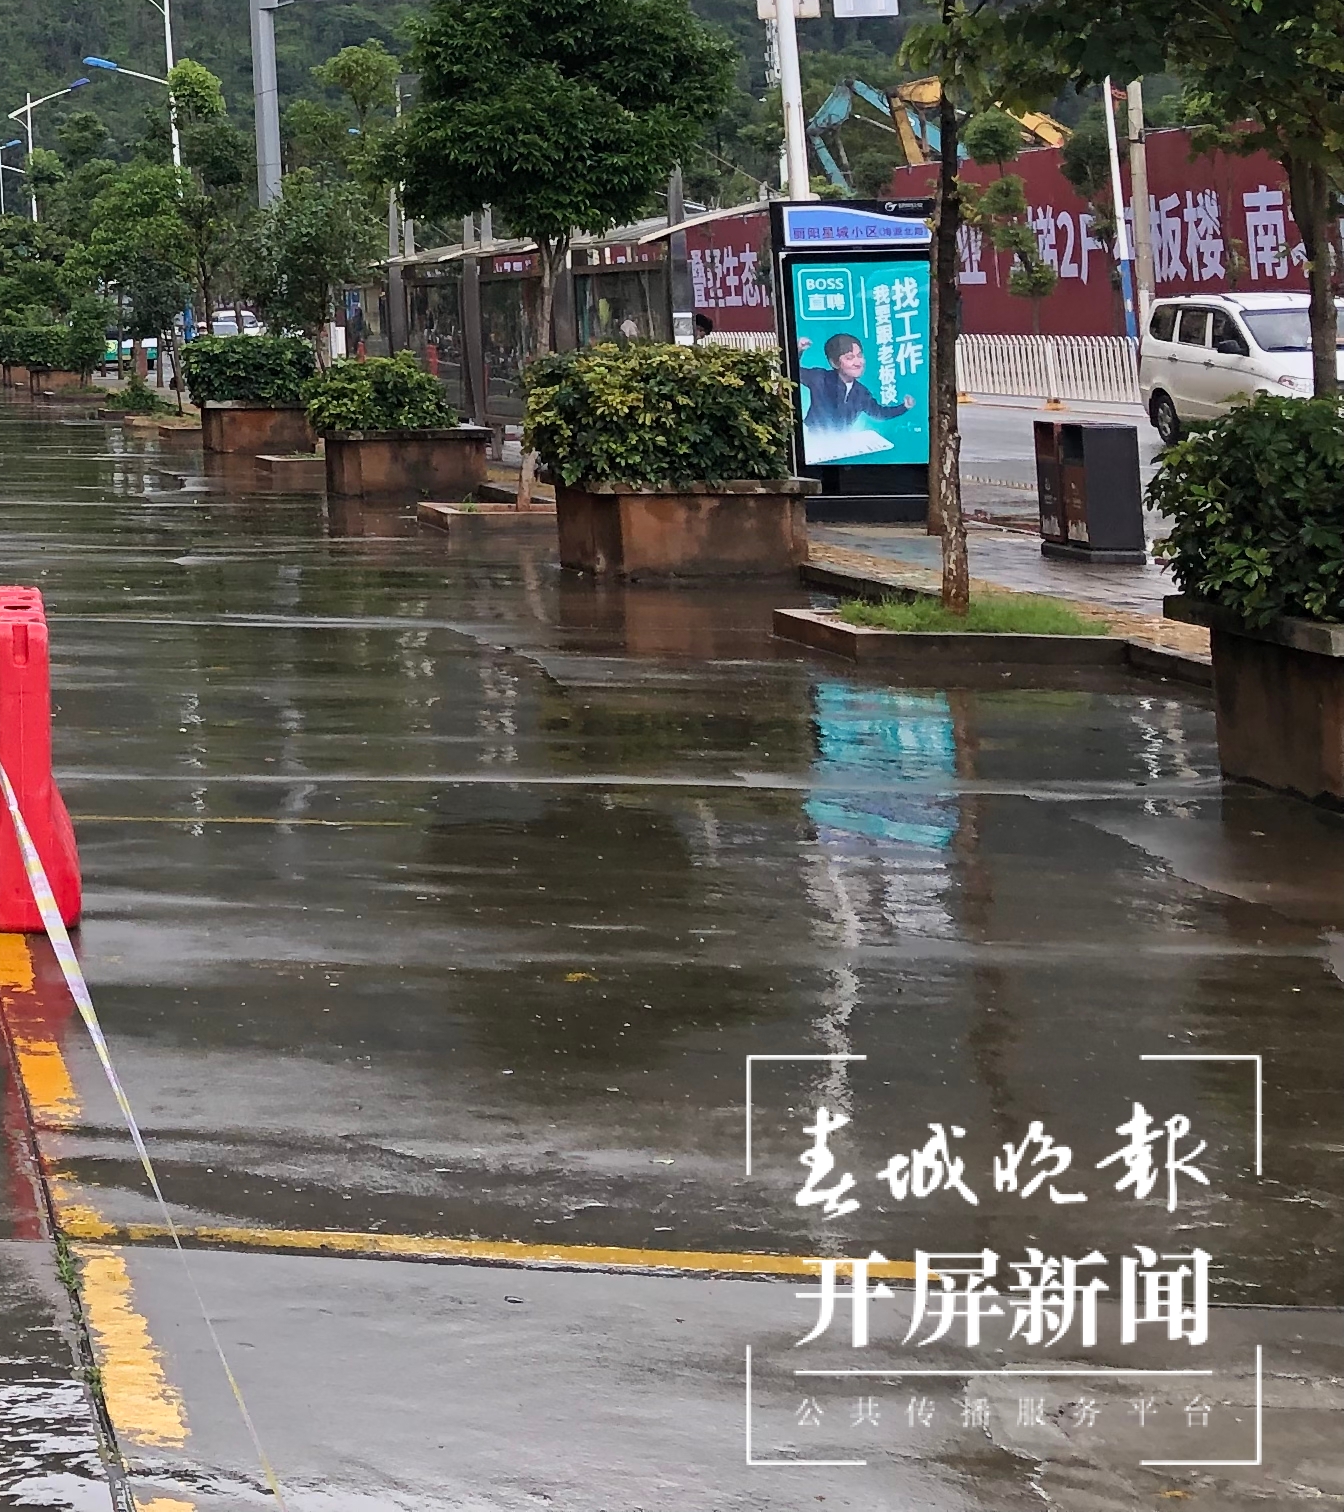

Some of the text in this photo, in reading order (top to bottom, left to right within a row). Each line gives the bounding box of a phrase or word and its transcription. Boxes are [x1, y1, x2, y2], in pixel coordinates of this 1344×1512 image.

[805, 277, 844, 291] BOSS
[808, 292, 845, 311] 直聘
[873, 283, 898, 405] 我要跟老板谈
[891, 276, 924, 376] 找工作
